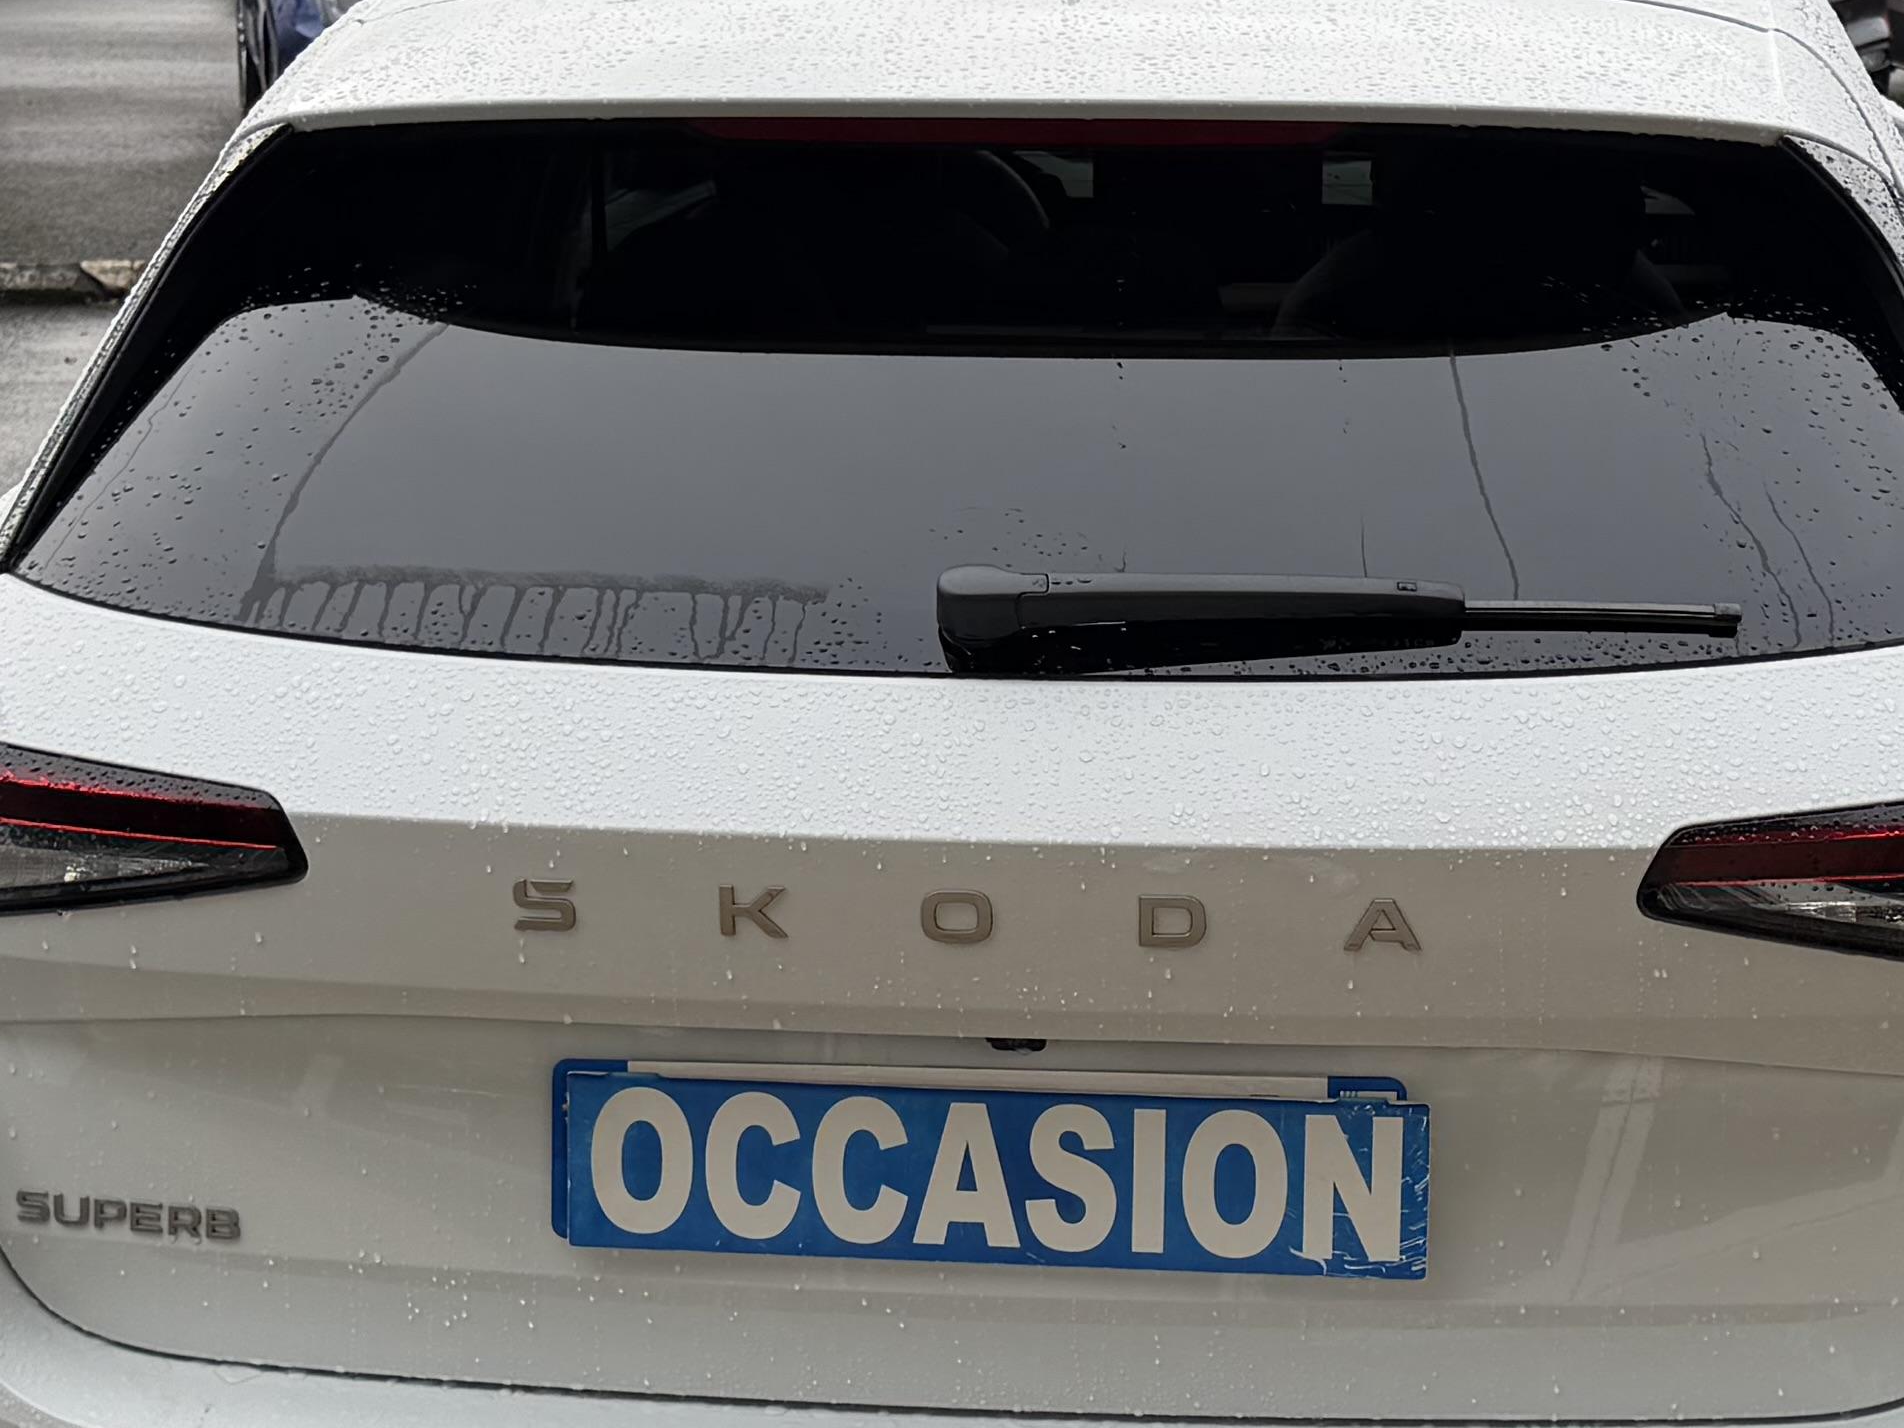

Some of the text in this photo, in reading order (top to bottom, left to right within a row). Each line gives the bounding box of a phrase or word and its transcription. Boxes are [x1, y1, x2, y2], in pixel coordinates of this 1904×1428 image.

[512, 877, 1424, 953] SKODA
[590, 1086, 1404, 1263] OCCASION
[15, 1189, 242, 1240] SUPERB
